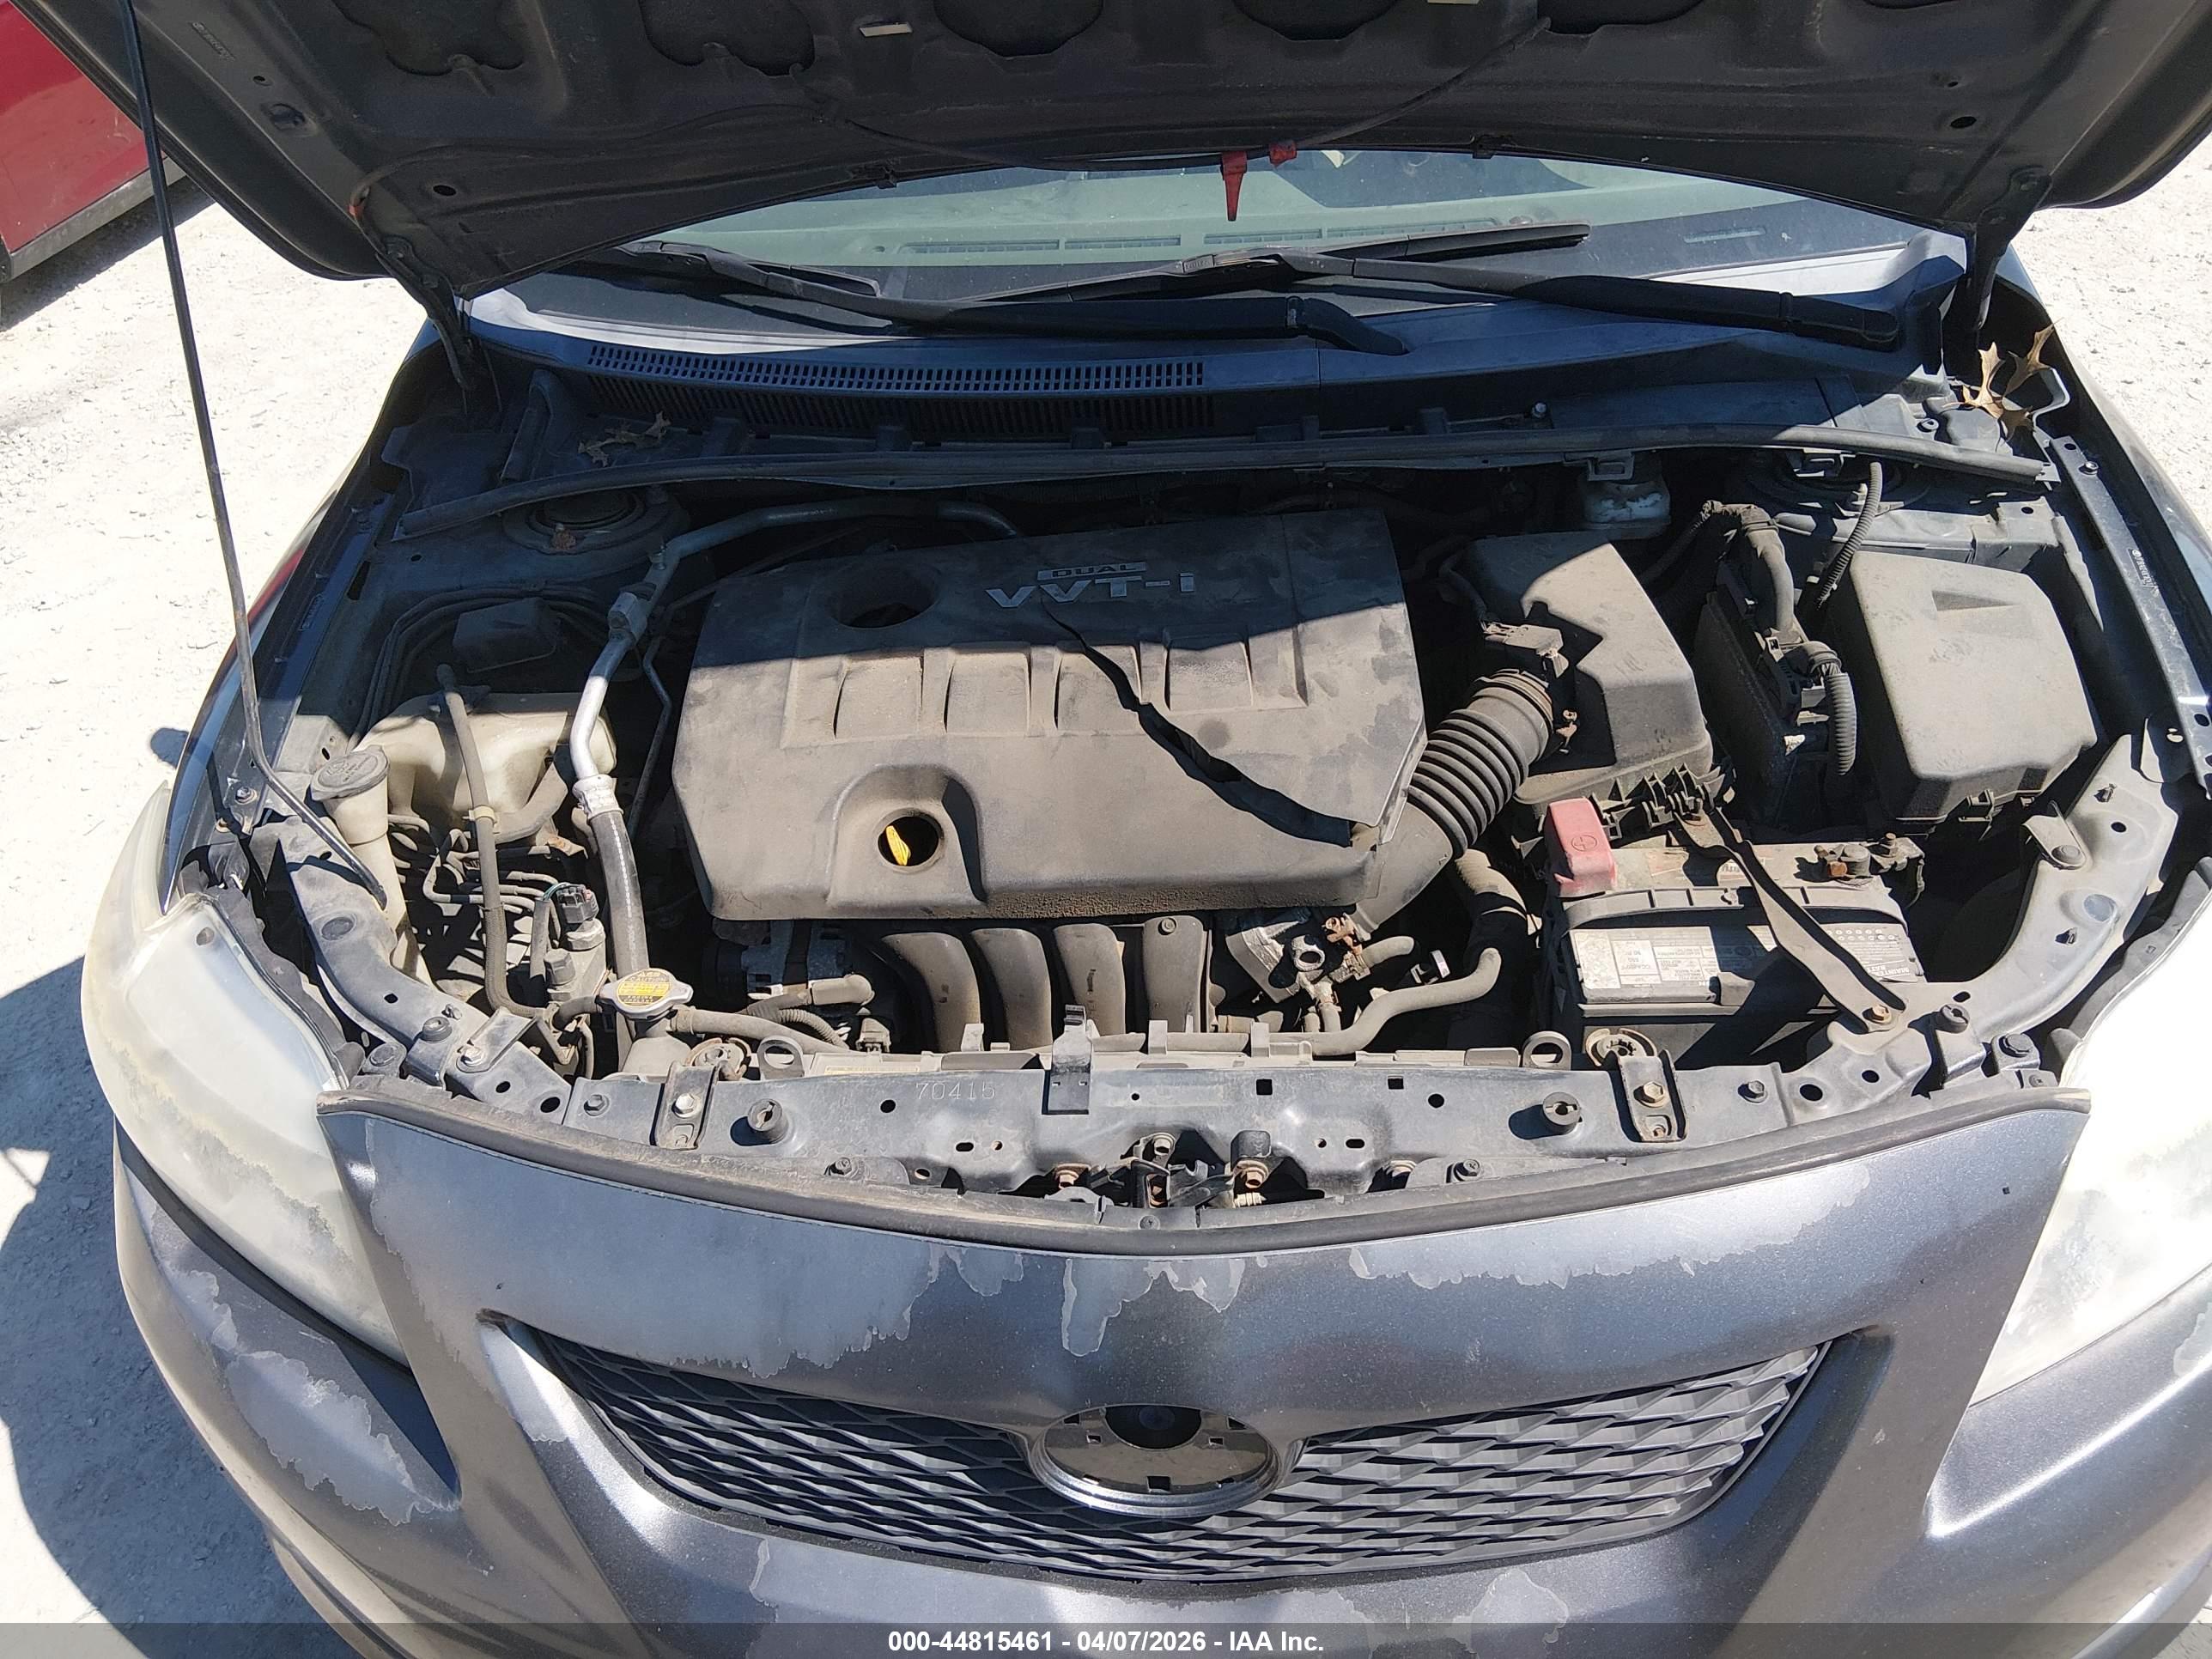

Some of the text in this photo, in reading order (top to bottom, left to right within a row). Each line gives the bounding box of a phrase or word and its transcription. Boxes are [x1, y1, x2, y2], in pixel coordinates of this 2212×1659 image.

[1052, 563, 1136, 577] DUAL
[985, 573, 1194, 608] VVT-i
[915, 1081, 995, 1100] 70415
